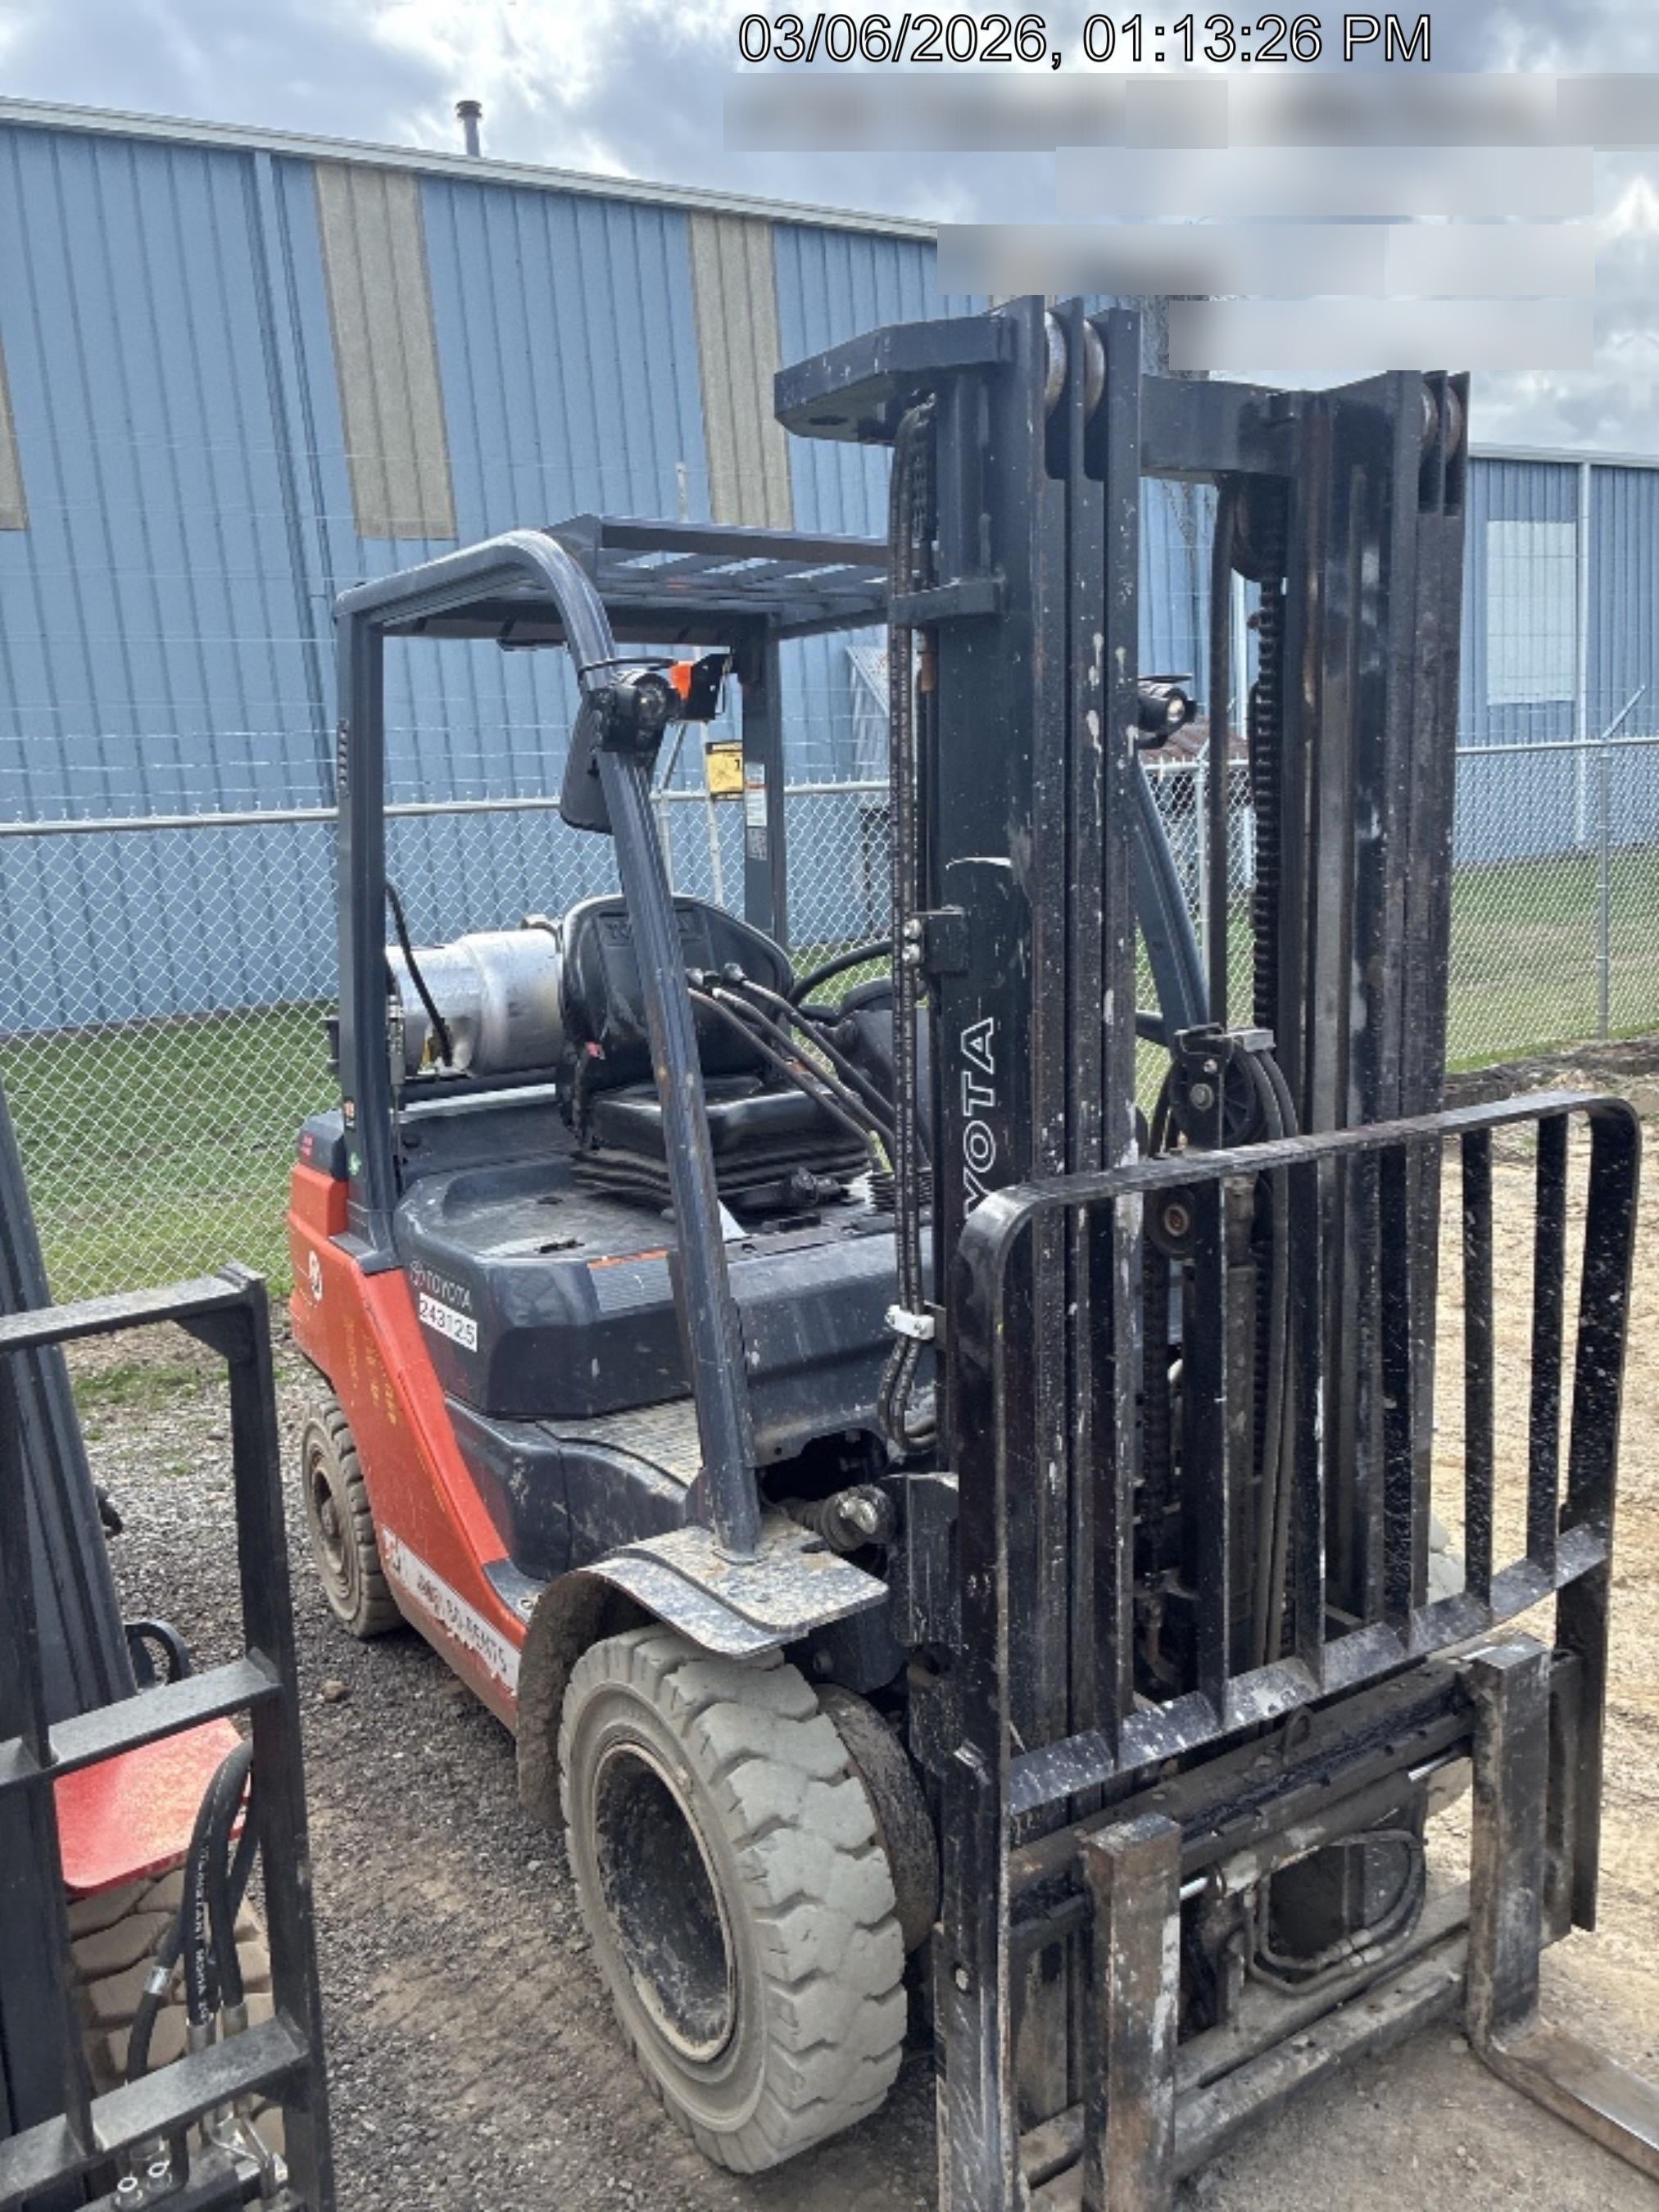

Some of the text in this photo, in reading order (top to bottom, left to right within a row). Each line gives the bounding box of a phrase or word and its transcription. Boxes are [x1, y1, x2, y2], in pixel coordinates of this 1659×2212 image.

[961, 1016, 996, 1219] YOTA
[425, 1270, 473, 1312] TOYOTA
[419, 1299, 475, 1346] 243125
